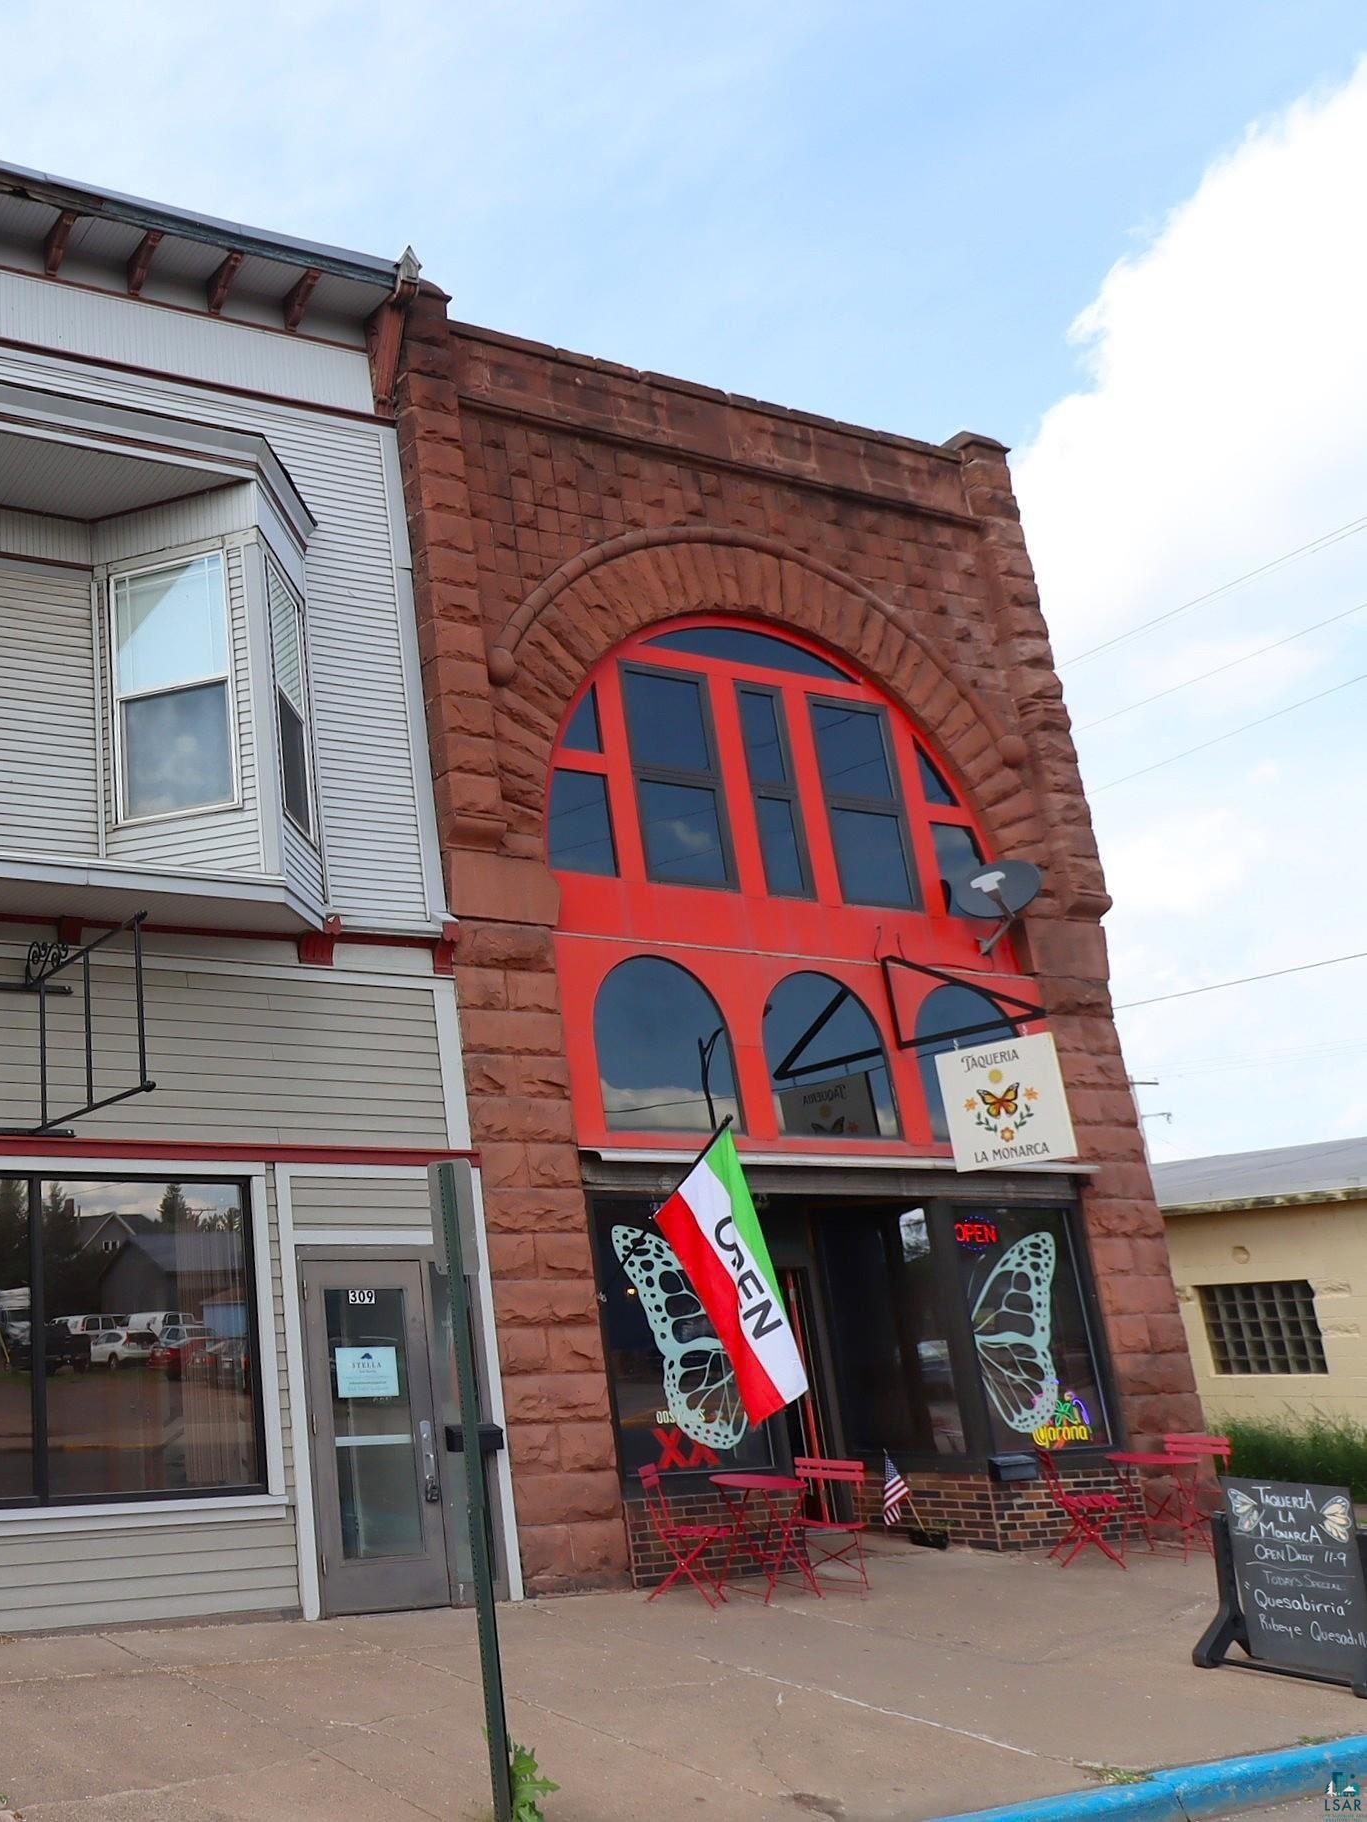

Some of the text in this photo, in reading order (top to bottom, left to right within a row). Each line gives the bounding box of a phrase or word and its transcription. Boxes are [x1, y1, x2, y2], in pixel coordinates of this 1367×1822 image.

[961, 1049, 1020, 1073] TAQUERIA
[974, 1142, 1050, 1163] LA MONARCA
[954, 1224, 998, 1243] OPEN
[350, 1290, 374, 1303] 309
[1033, 1425, 1089, 1448] Corona
[1278, 1510, 1296, 1523] LA
[1254, 1544, 1285, 1561] OPEN
[1324, 1551, 1347, 1567] 11-9
[1258, 1613, 1367, 1648] Ribeye Quesadill
